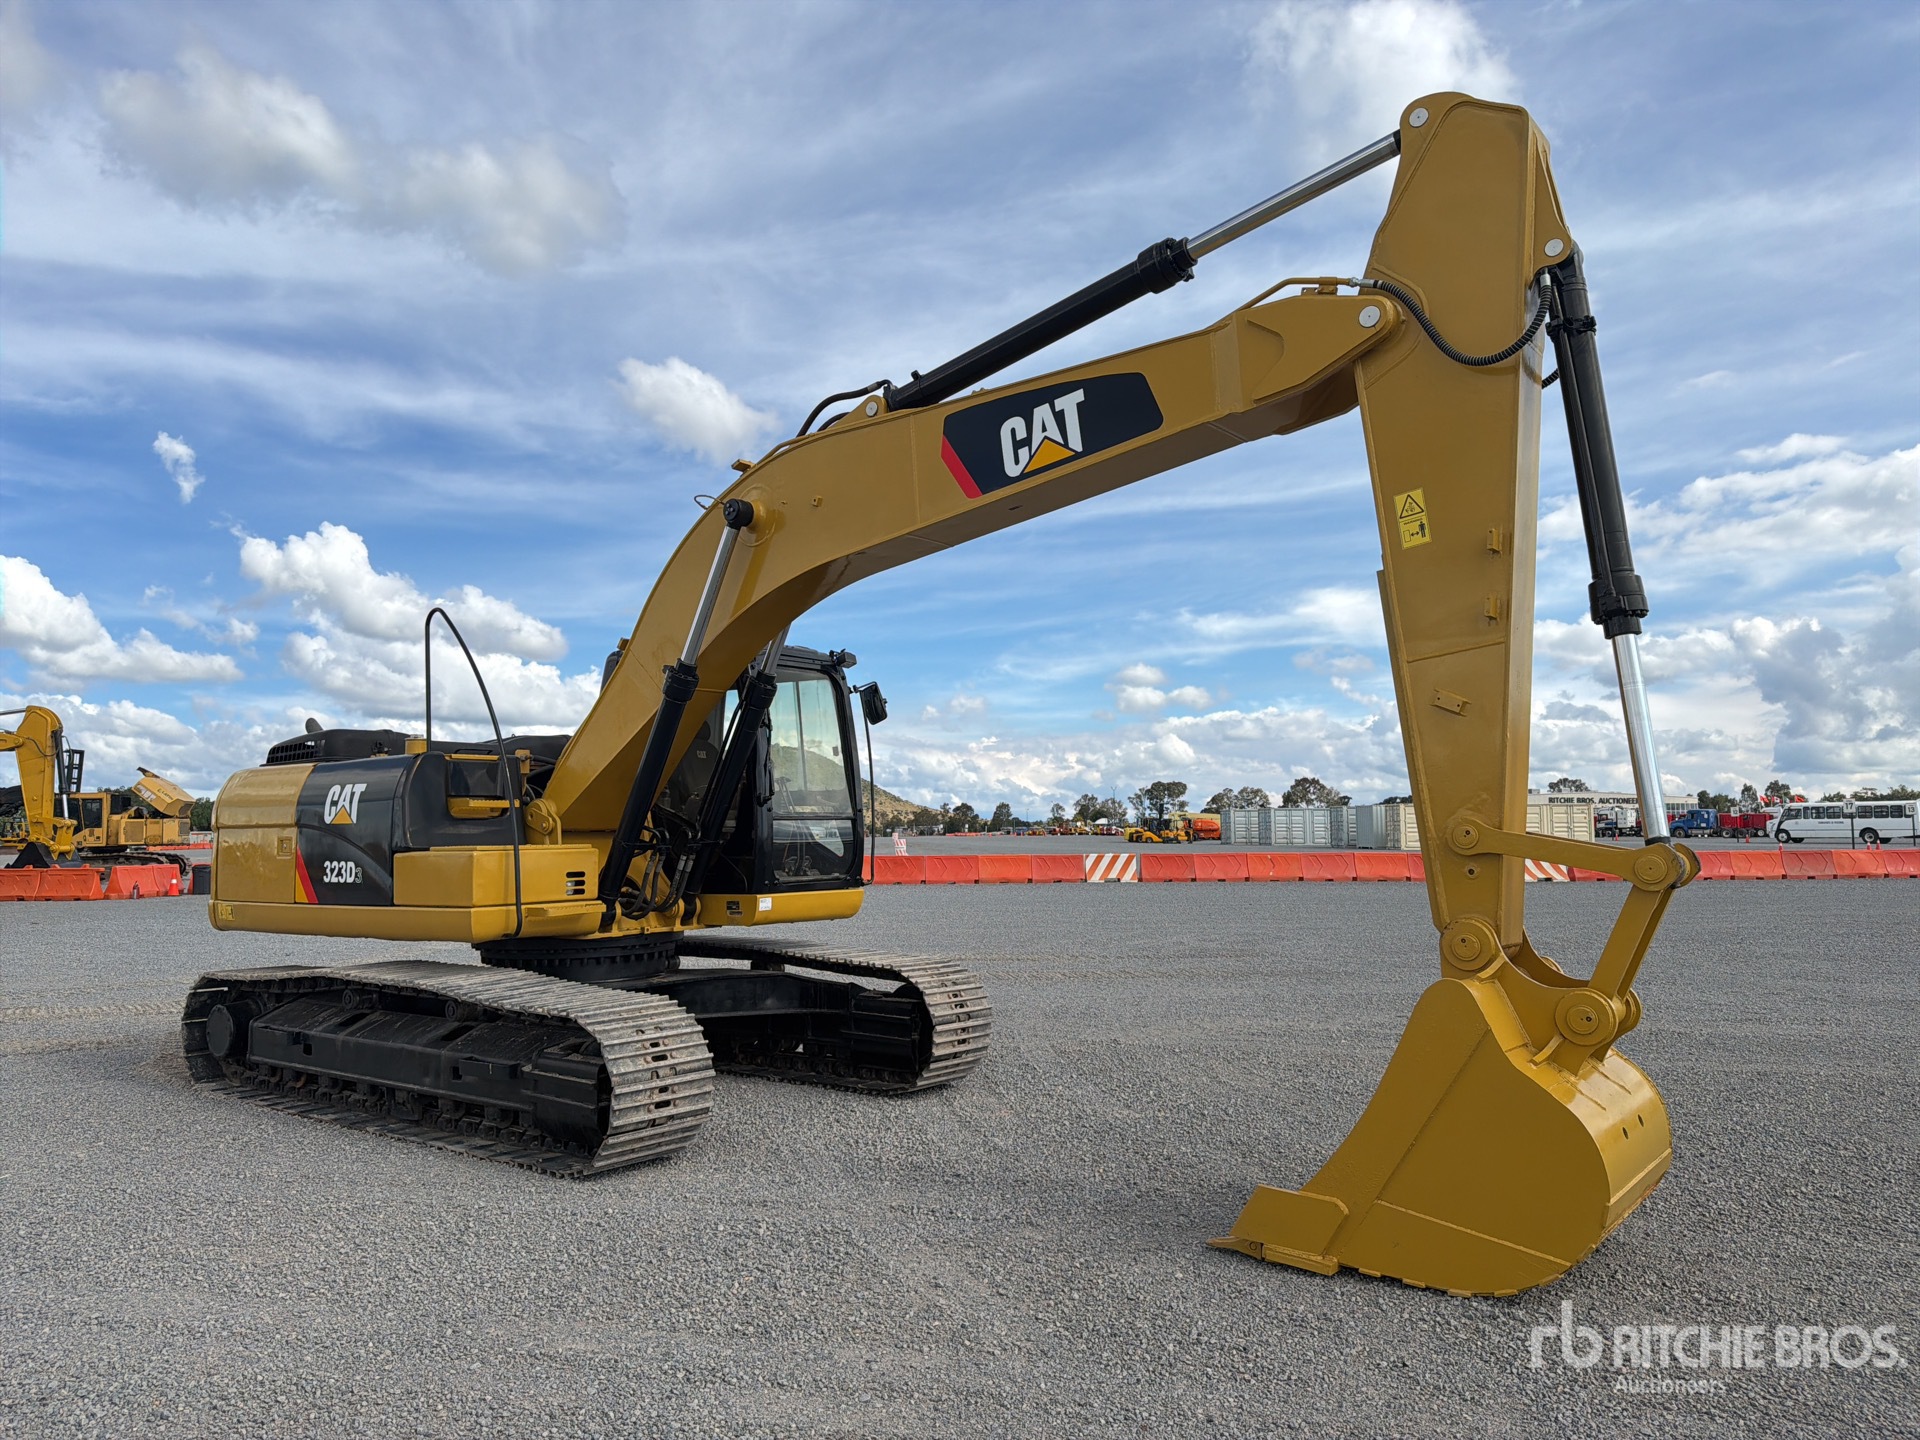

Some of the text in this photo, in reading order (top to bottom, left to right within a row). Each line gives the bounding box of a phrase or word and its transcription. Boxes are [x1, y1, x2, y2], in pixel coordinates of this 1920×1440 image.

[1000, 388, 1085, 478] CAT
[324, 783, 367, 824] CAT
[1845, 802, 1854, 810] 17
